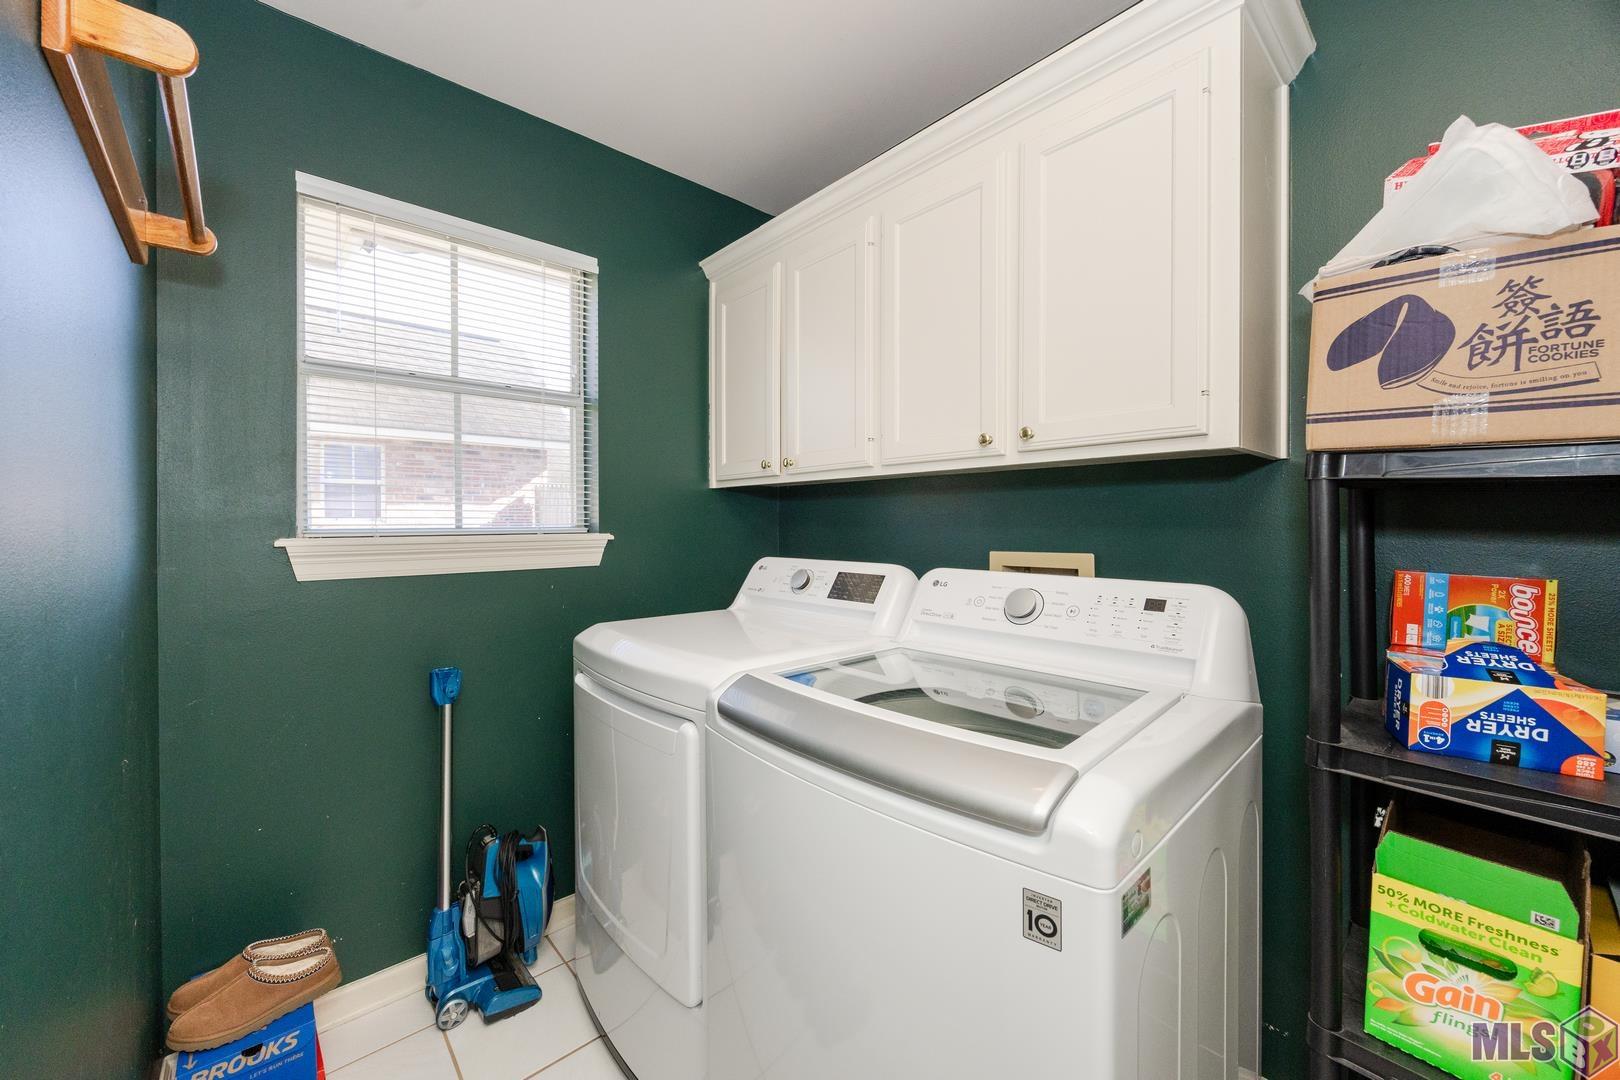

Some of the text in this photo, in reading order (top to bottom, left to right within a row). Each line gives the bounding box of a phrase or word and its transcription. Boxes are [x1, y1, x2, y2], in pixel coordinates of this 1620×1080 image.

[1527, 349, 1600, 364] COOKIES
[1528, 339, 1605, 355] FORTUNE
[1431, 376, 1448, 387] Smile
[1528, 375, 1558, 385] smiling
[1572, 370, 1588, 379] you
[1490, 584, 1498, 604] Power
[1498, 590, 1506, 599] 2X
[1508, 584, 1541, 655] bounce
[1545, 592, 1556, 653] 25% MORE SHEETS
[1505, 624, 1513, 646] SELEC
[1455, 655, 1536, 672] DRYER
[1465, 650, 1518, 662] SHEETS
[1479, 711, 1537, 726] SHEETS
[1466, 718, 1549, 743] DRYER
[1025, 895, 1058, 911] DIRECT DRIVE
[1027, 909, 1058, 938] 10
[1039, 922, 1052, 930] YEAR
[1377, 884, 1410, 904] 50%
[1413, 896, 1464, 924] MORE
[1467, 916, 1560, 957] Freshness
[1489, 936, 1543, 964] Clean
[1403, 972, 1503, 1022] Gain
[190, 1030, 301, 1080] BROOKS
[249, 1051, 305, 1080] LET'S RUN THERE
